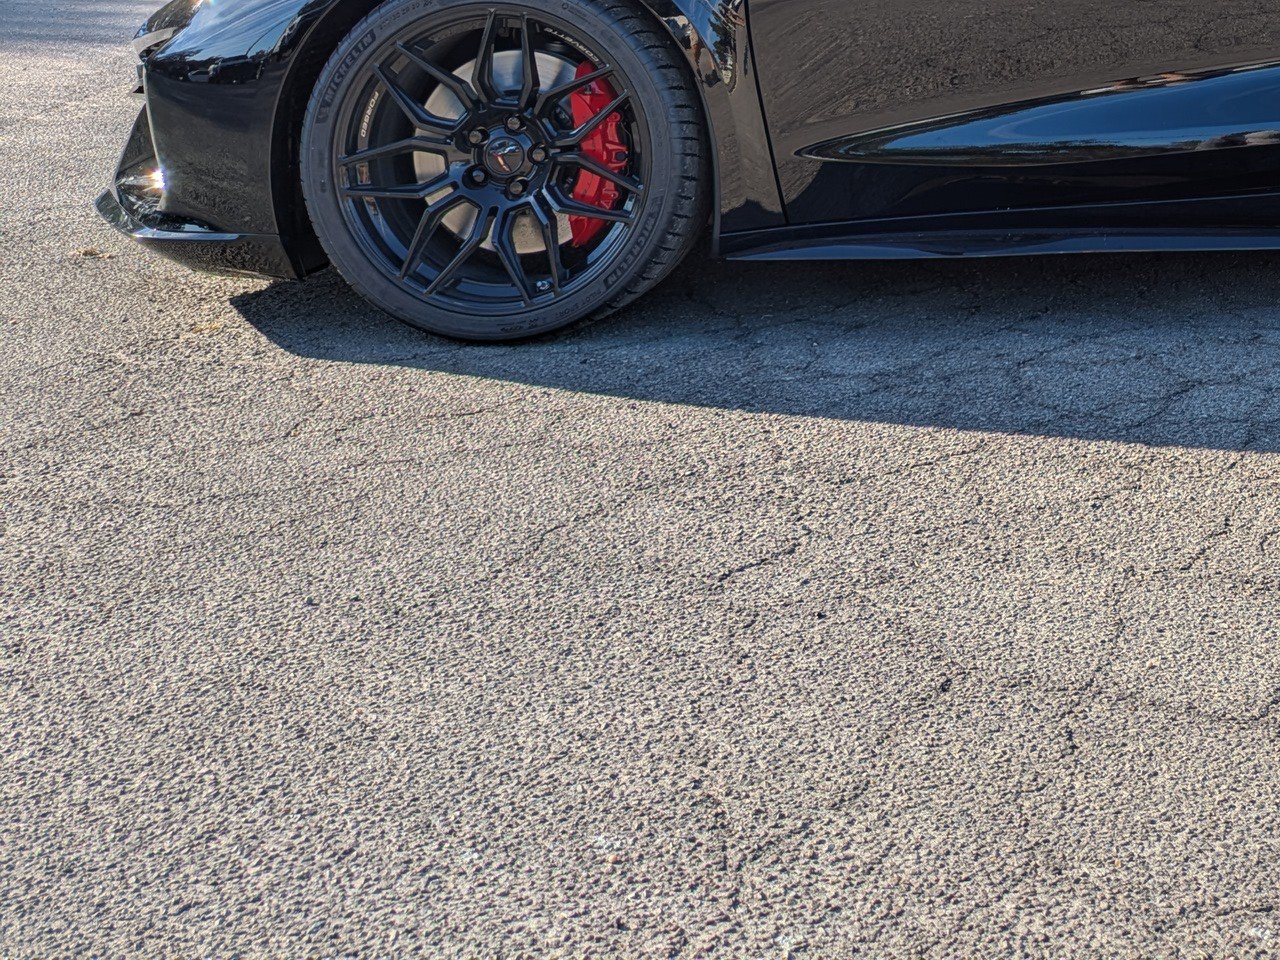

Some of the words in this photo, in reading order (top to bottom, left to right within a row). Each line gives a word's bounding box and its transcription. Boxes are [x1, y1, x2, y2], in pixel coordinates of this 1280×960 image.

[324, 30, 375, 103] MICHELIN
[360, 90, 380, 138] FORGED
[607, 216, 657, 286] MICHELIN
